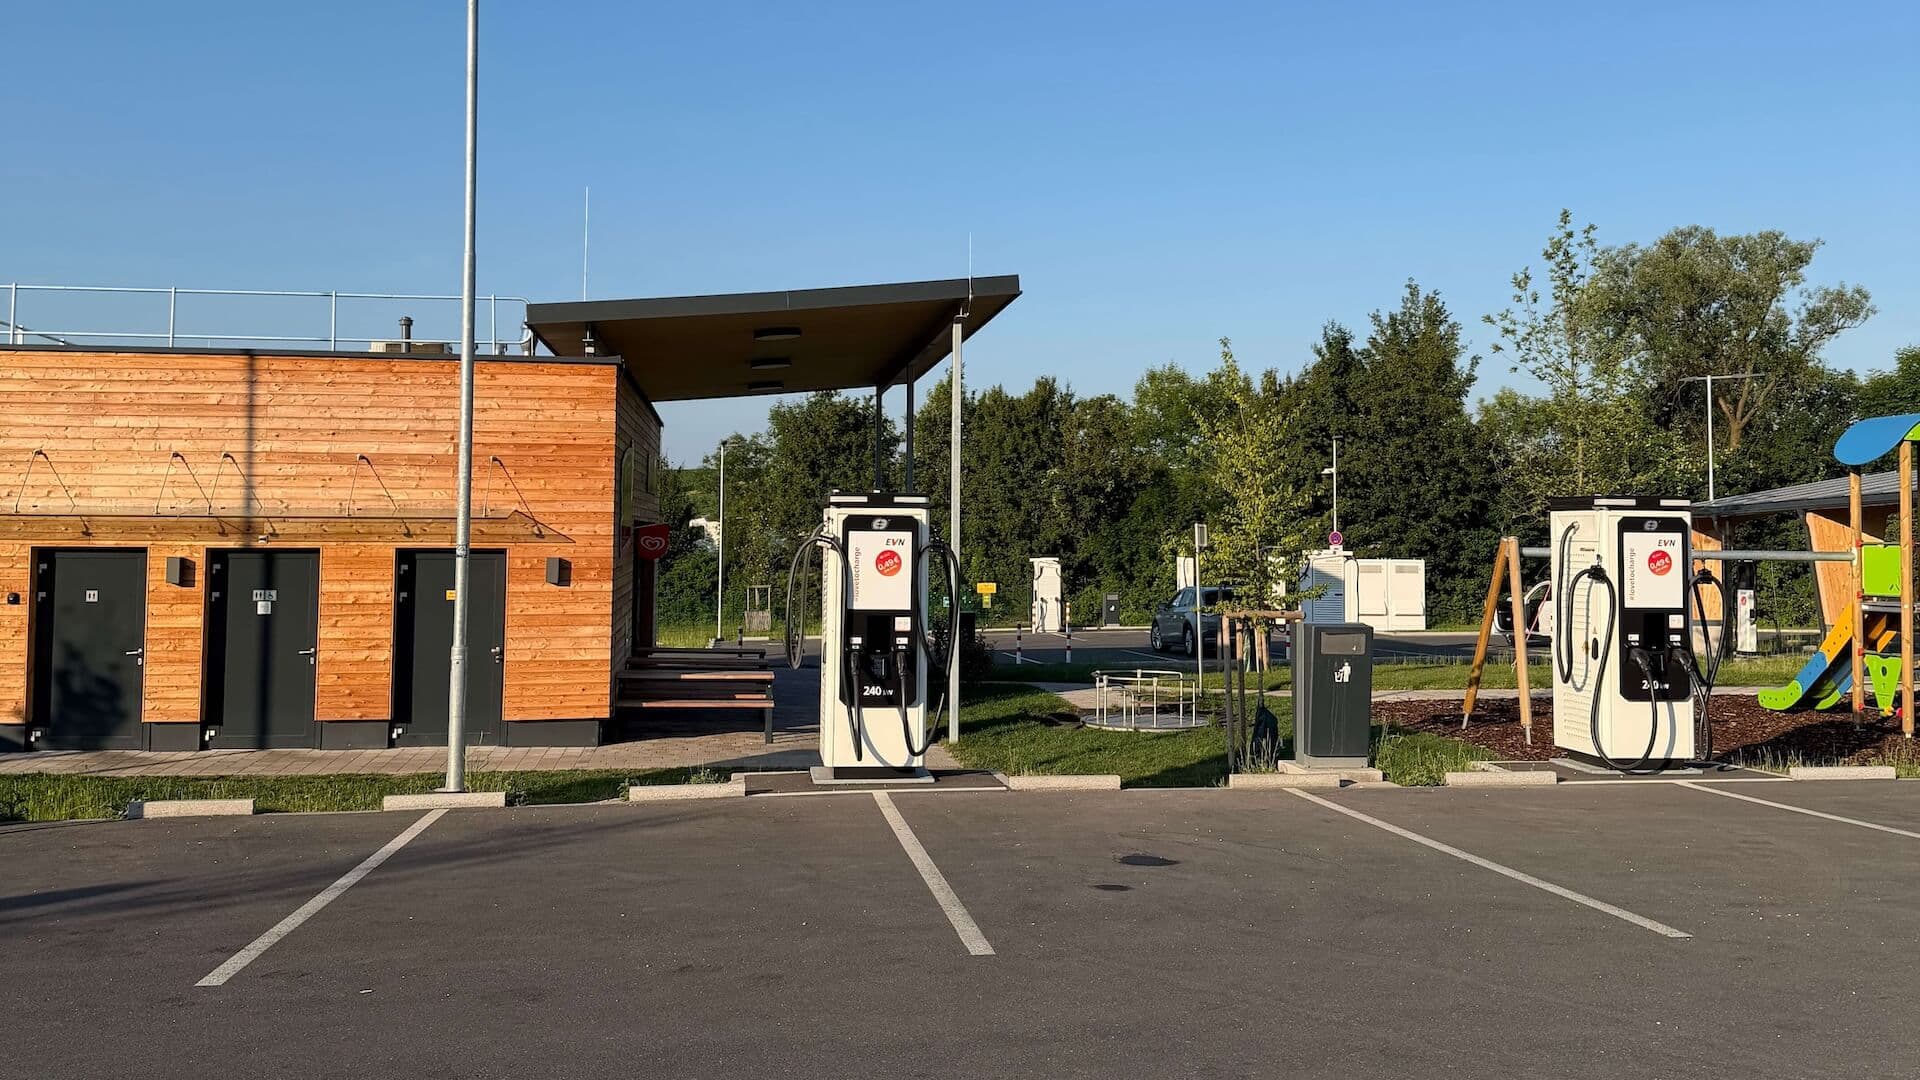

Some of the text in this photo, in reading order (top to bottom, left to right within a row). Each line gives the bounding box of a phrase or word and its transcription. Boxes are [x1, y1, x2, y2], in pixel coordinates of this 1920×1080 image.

[885, 538, 906, 546] EVN
[1657, 539, 1676, 547] EVN
[1641, 679, 1659, 690] 20
[863, 685, 882, 696] 240
